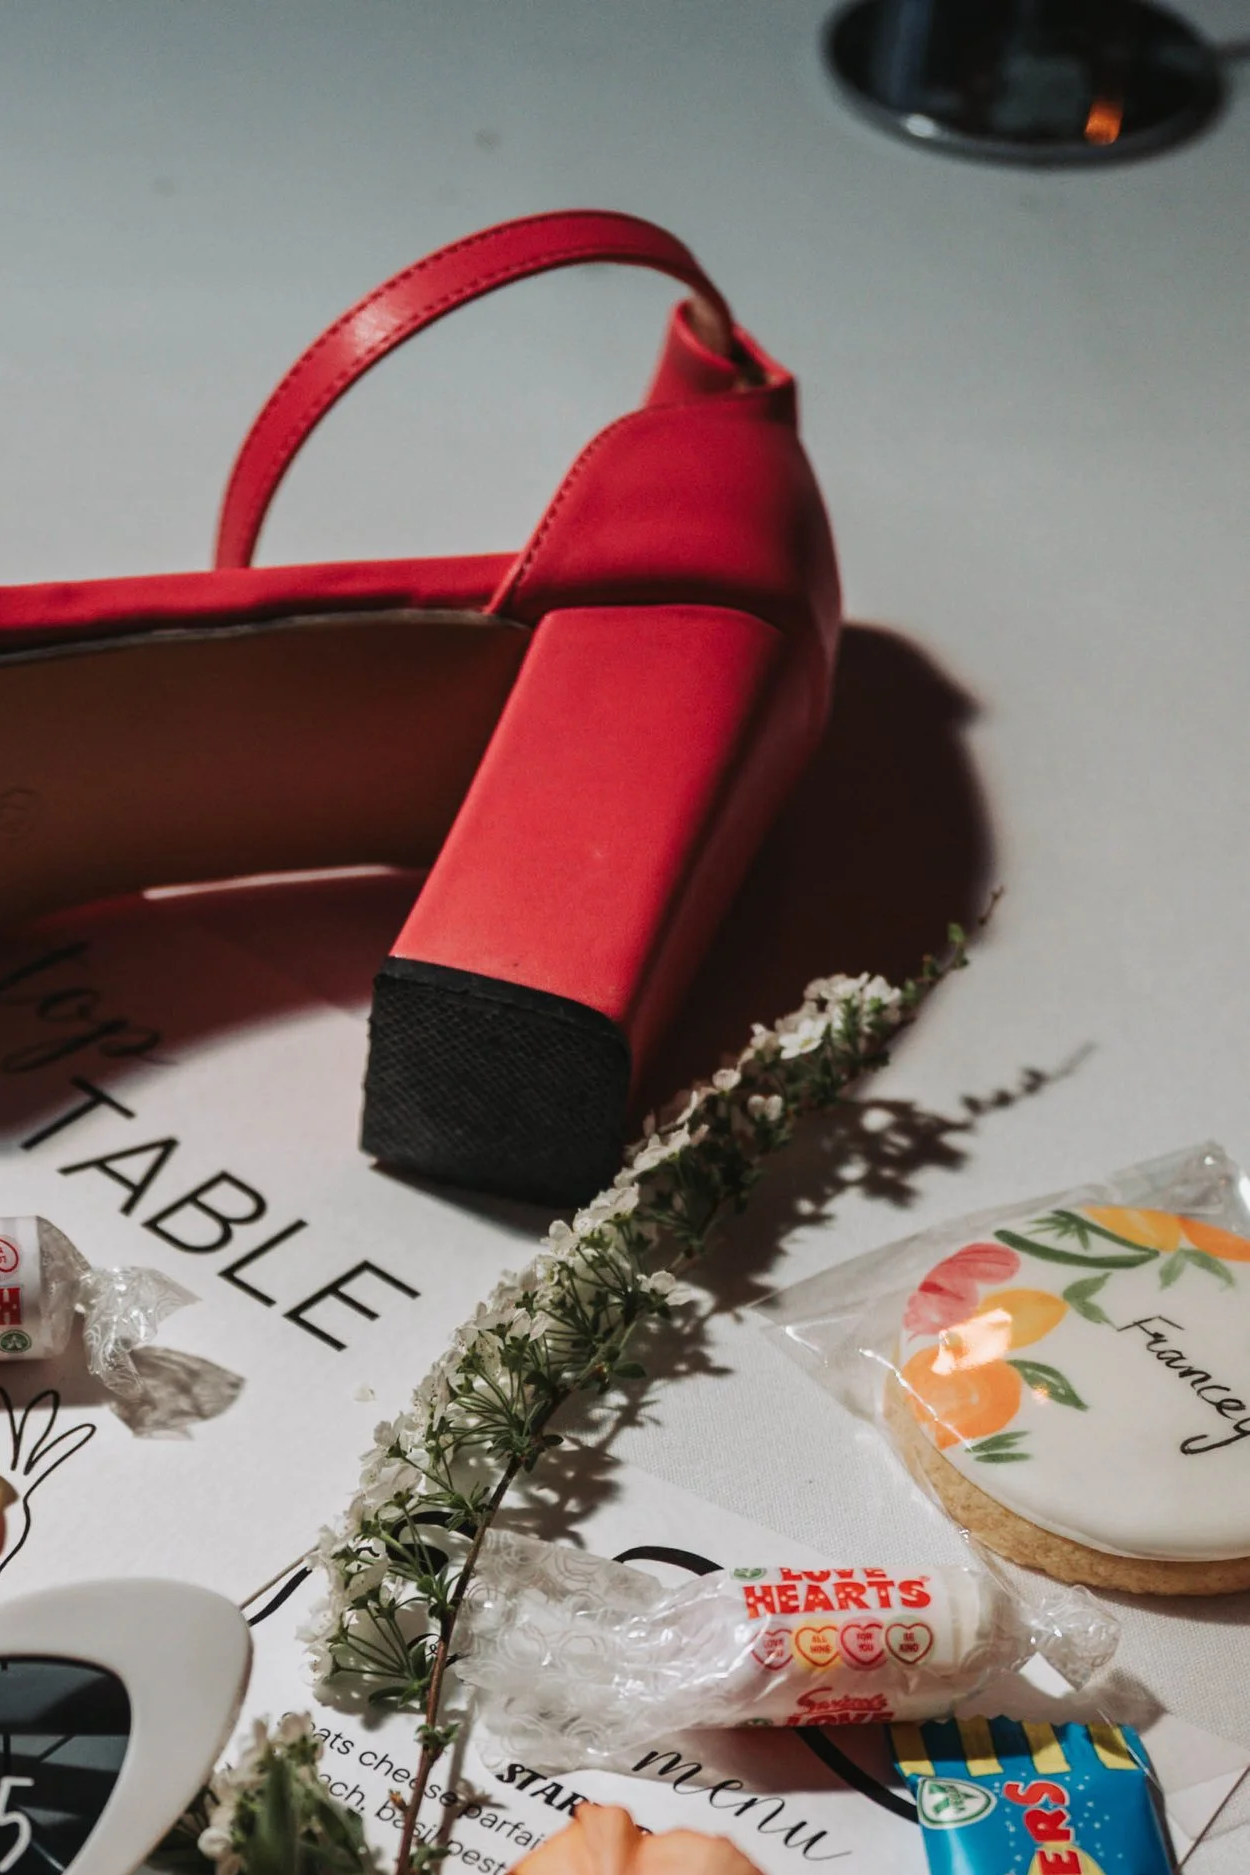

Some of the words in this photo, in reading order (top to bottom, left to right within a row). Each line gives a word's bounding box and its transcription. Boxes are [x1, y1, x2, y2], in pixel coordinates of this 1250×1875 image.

[20, 1076, 422, 1353] TABLE
[743, 1580, 932, 1619] HEARTS
[456, 1802, 546, 1852] parfai
[631, 1749, 853, 1862] menu
